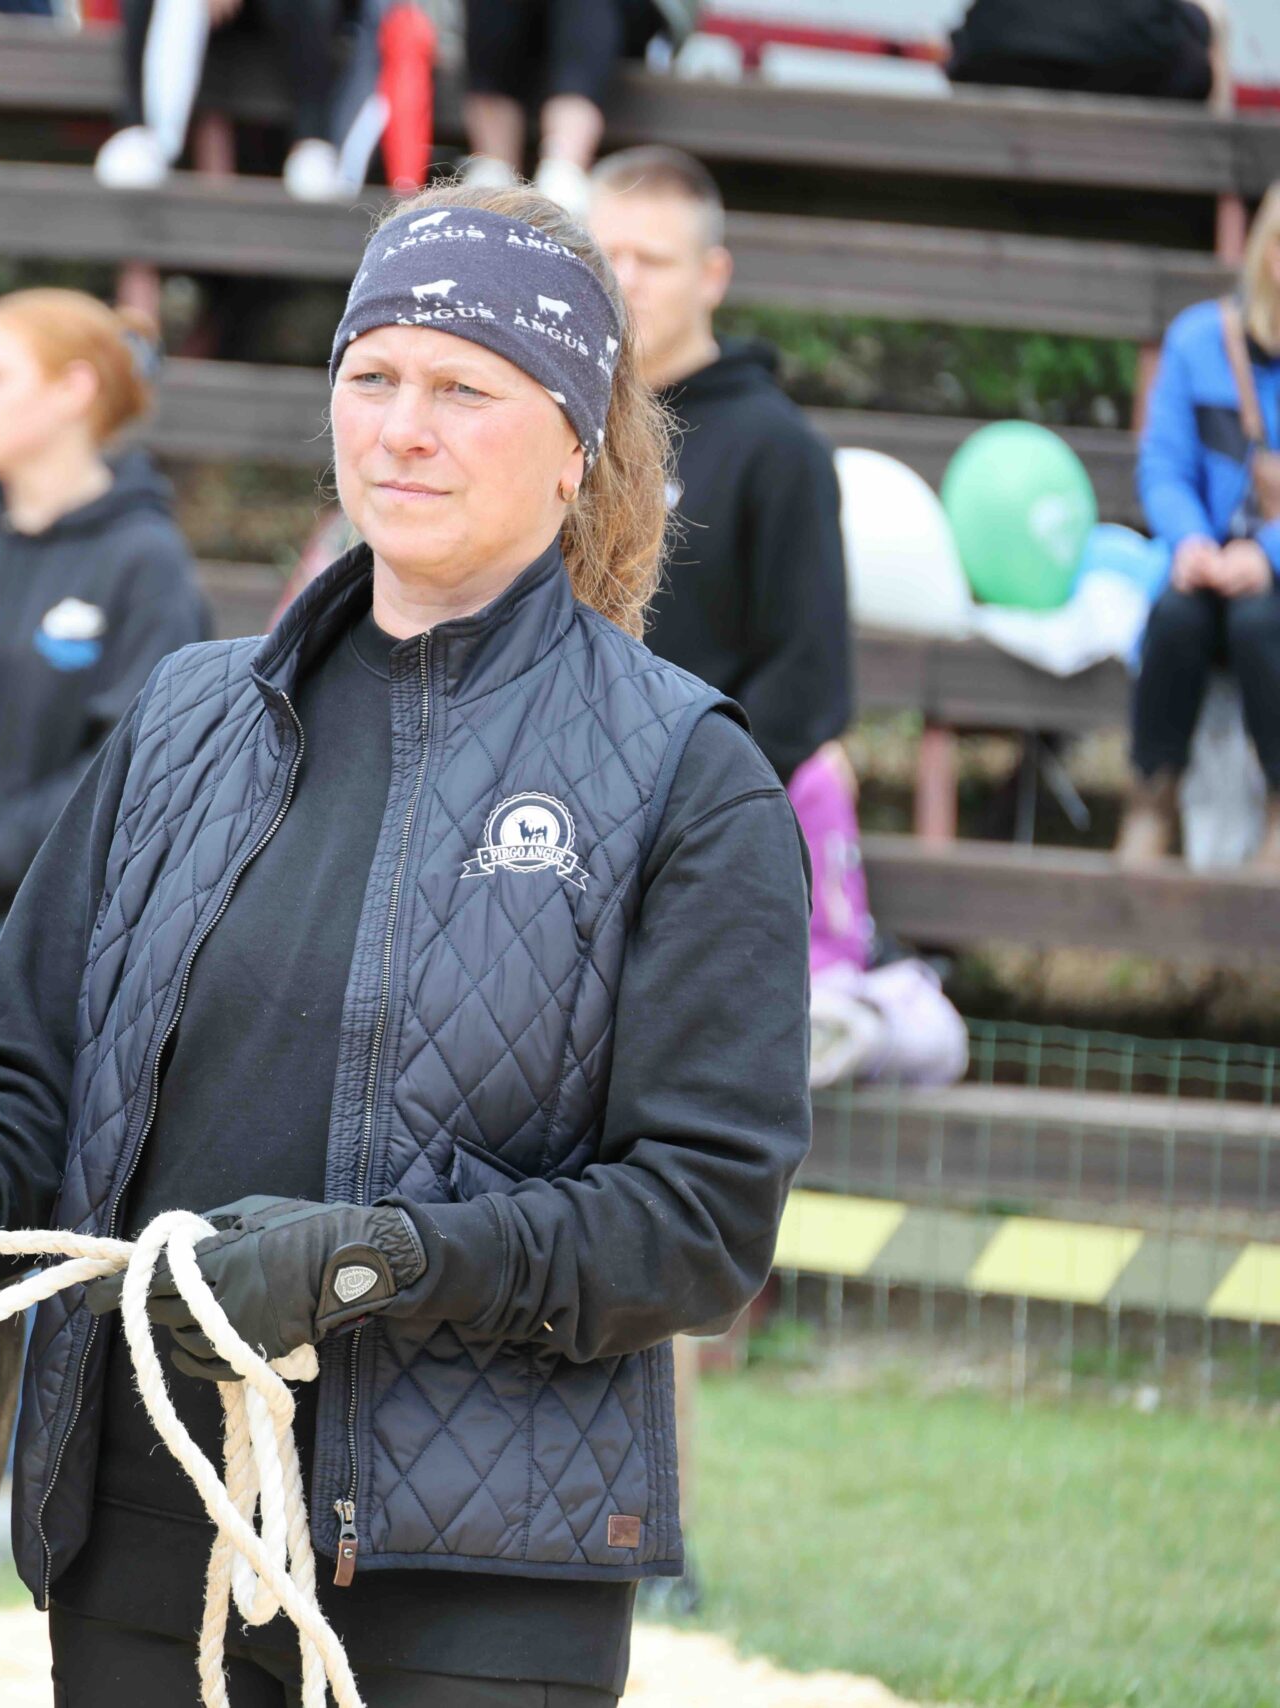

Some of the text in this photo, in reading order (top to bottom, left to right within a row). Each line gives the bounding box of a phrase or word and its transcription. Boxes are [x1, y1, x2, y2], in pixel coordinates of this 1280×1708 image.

[396, 306, 495, 327] ANGUS
[512, 314, 590, 356] ANGUS
[489, 846, 566, 863] PIRGO ANGUS
